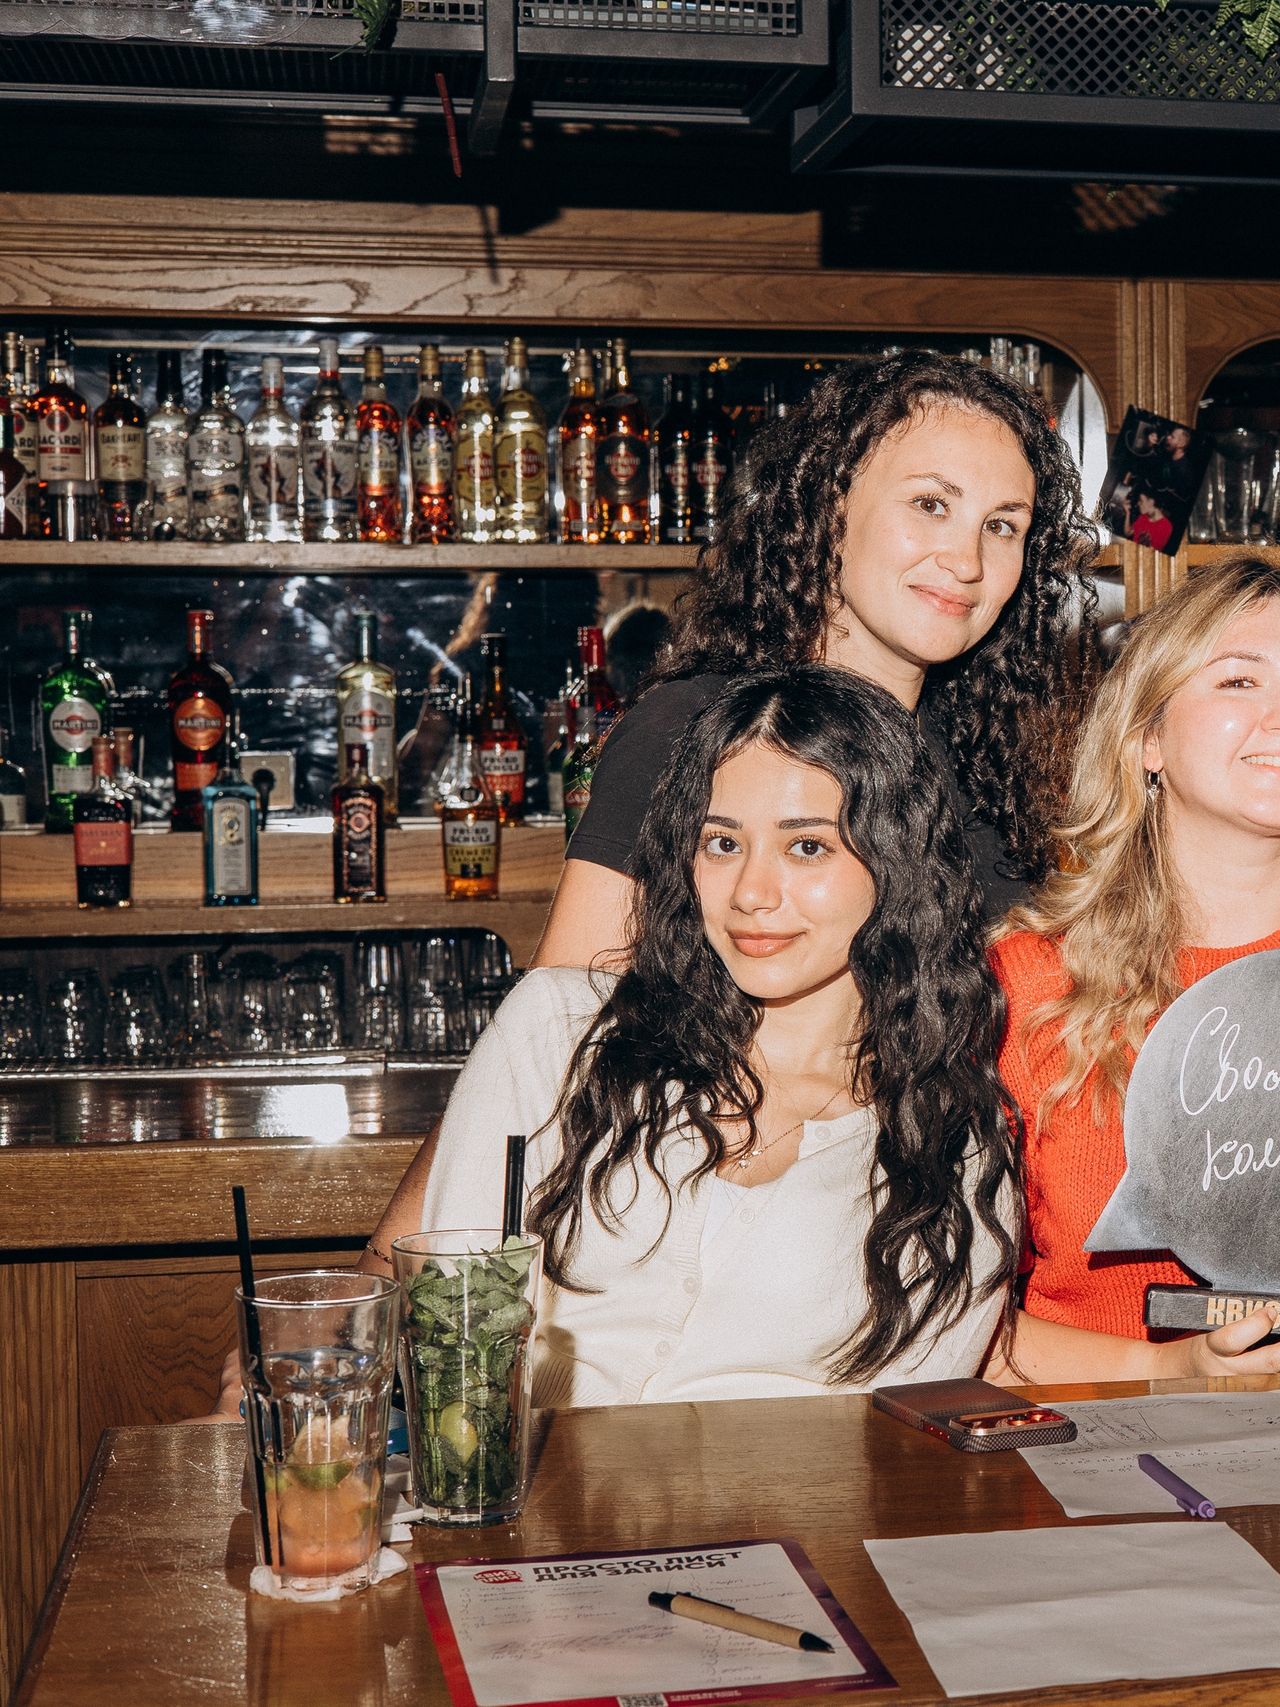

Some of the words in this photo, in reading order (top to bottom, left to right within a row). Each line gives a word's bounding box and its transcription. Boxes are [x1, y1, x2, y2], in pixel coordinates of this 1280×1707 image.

[346, 716, 392, 727] MATINI
[533, 1559, 656, 1575] ПРОСТО
[665, 1551, 742, 1565] ЛИСТ
[535, 1571, 598, 1582] ДЛЯ
[606, 1560, 726, 1576] ЗАПИСИ
